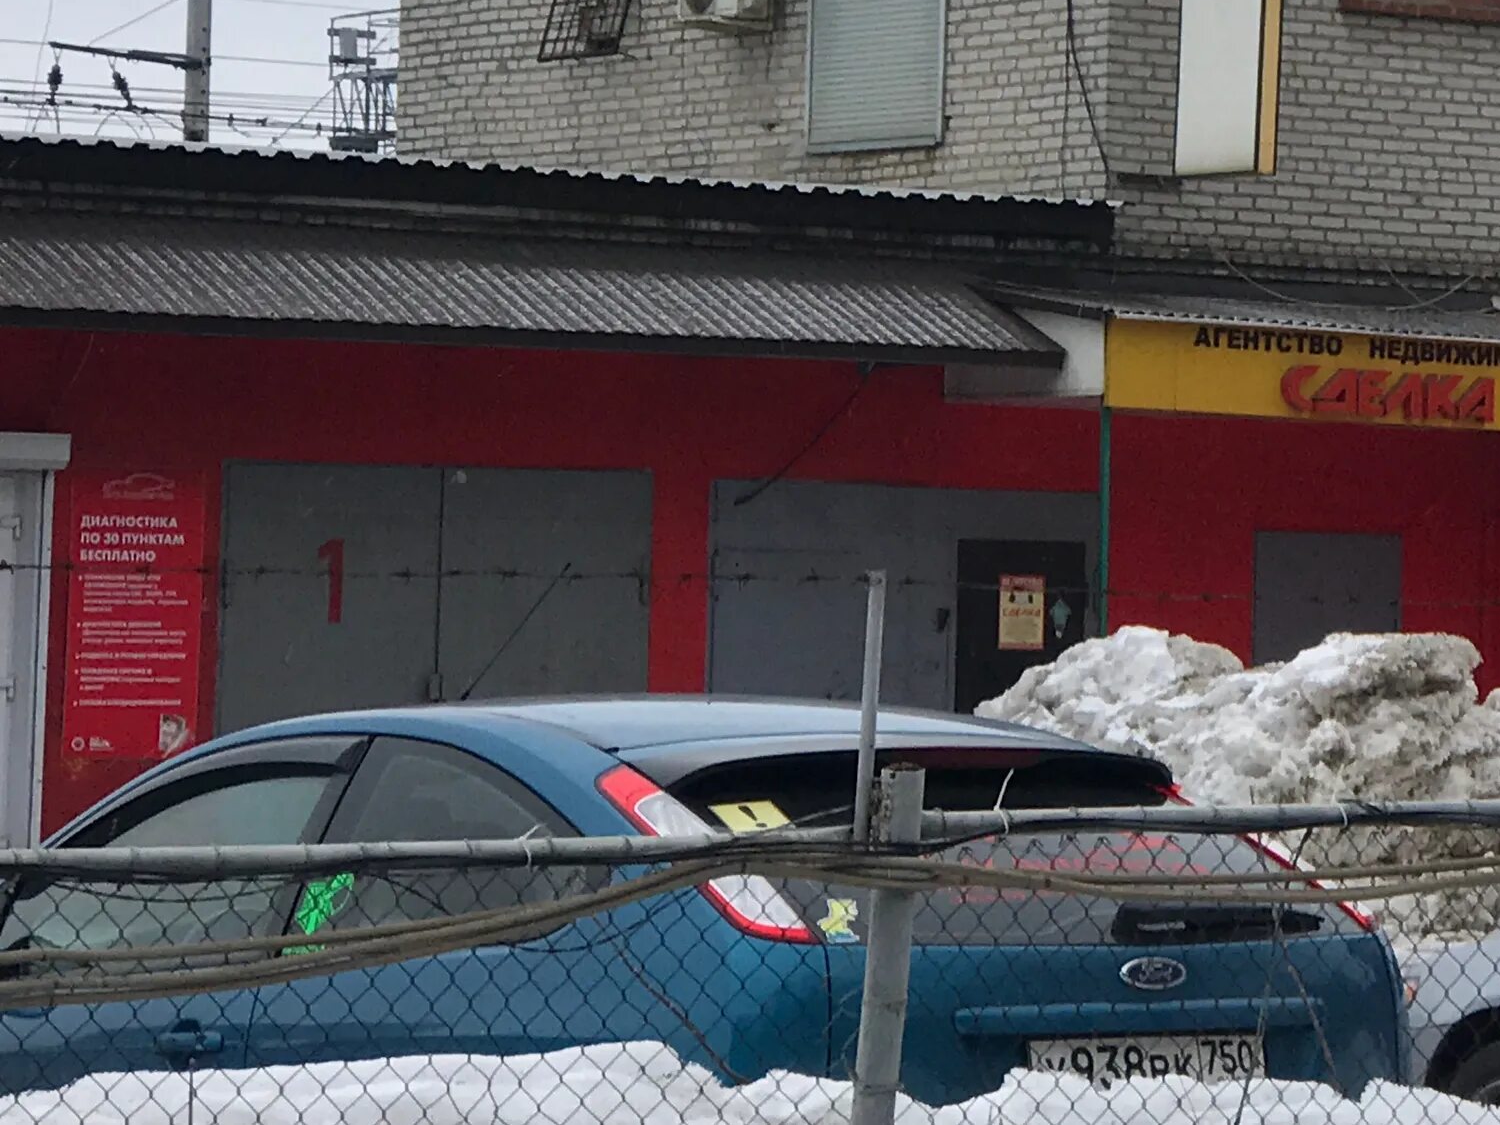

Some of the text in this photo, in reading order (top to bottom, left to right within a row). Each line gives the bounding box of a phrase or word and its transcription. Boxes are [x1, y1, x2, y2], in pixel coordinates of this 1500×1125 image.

[1193, 326, 1343, 356] АГЕНТСТВО
[1280, 364, 1496, 425] СДЕЛКА
[80, 515, 178, 528] ДИАГНОСТИКА
[80, 532, 185, 545] ПО 30 ПУНКТАМ
[80, 550, 156, 562] БЕСПЛАТНО
[317, 537, 344, 625] 1
